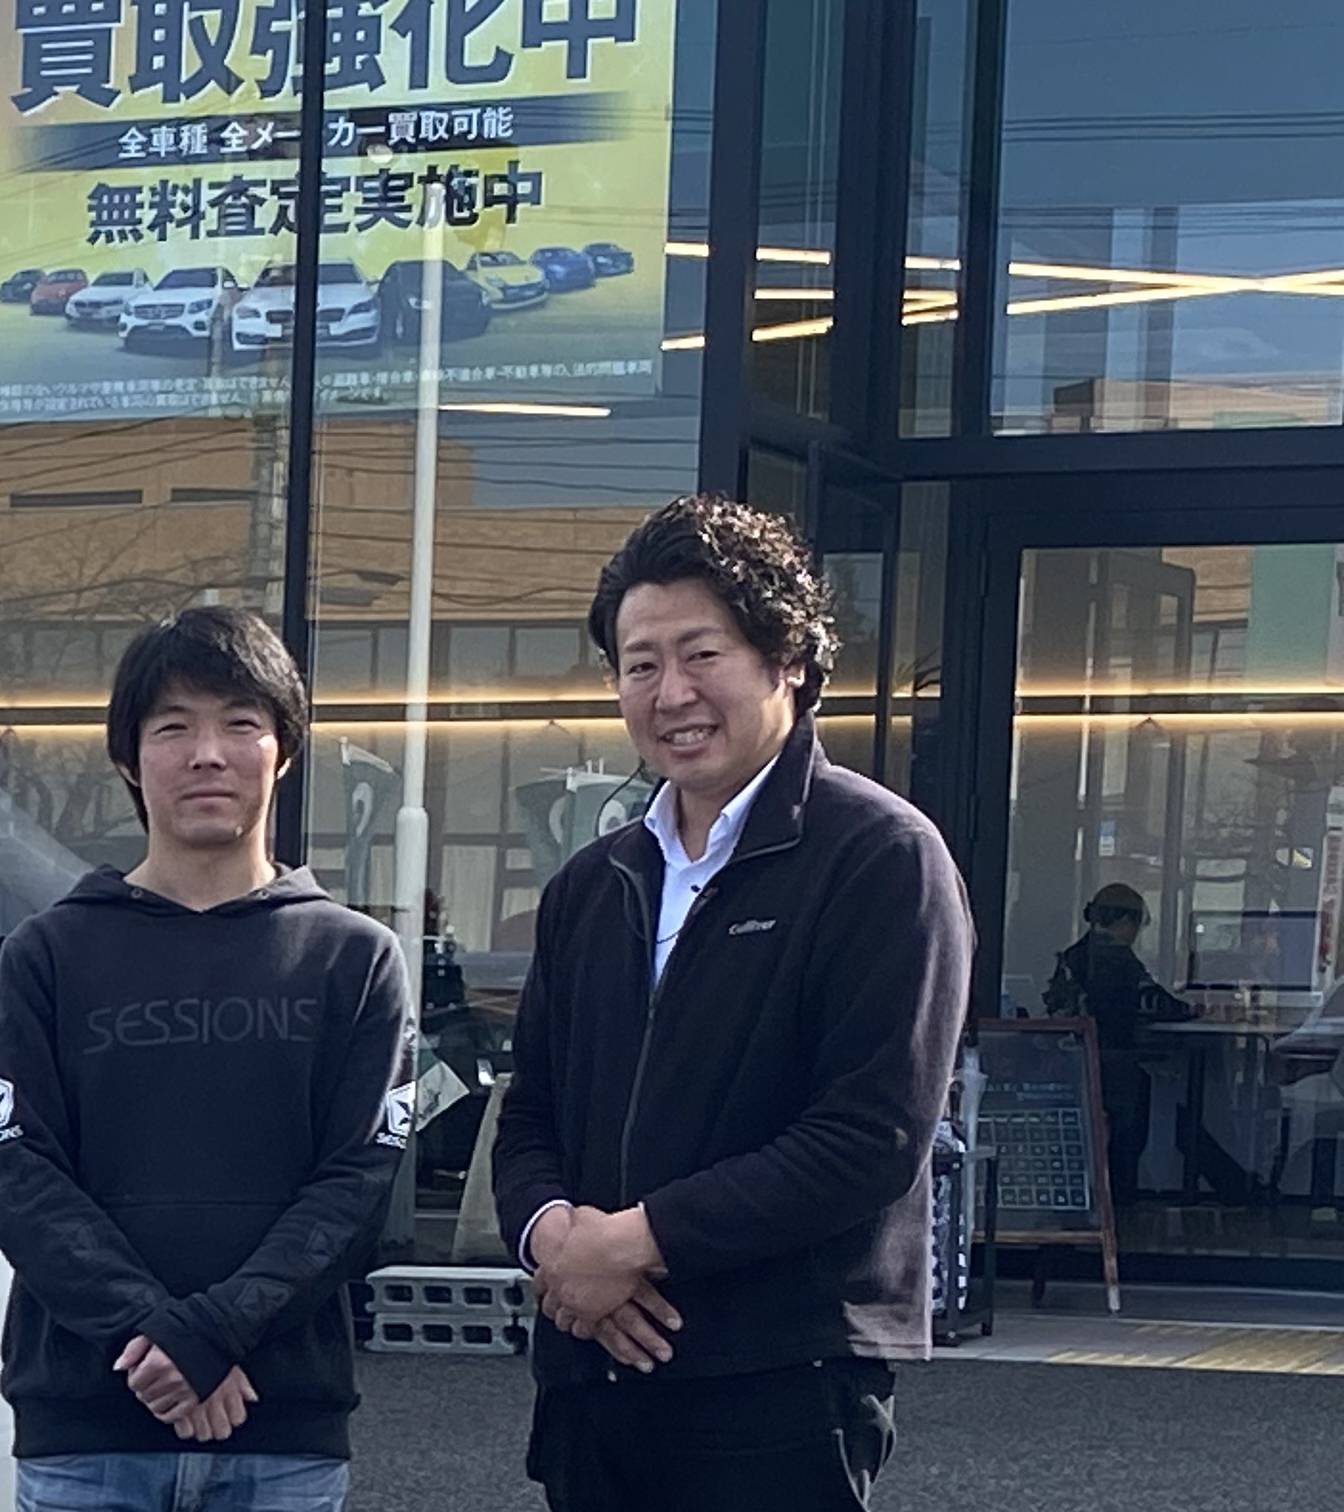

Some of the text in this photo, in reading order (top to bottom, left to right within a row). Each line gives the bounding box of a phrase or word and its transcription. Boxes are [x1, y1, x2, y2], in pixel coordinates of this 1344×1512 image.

[10, 0, 638, 112] 買取強化中
[117, 106, 515, 160] 全車種 全メーカー買取可能
[86, 159, 545, 246] 無料査定実施中
[83, 996, 319, 1055] SESSIONS
